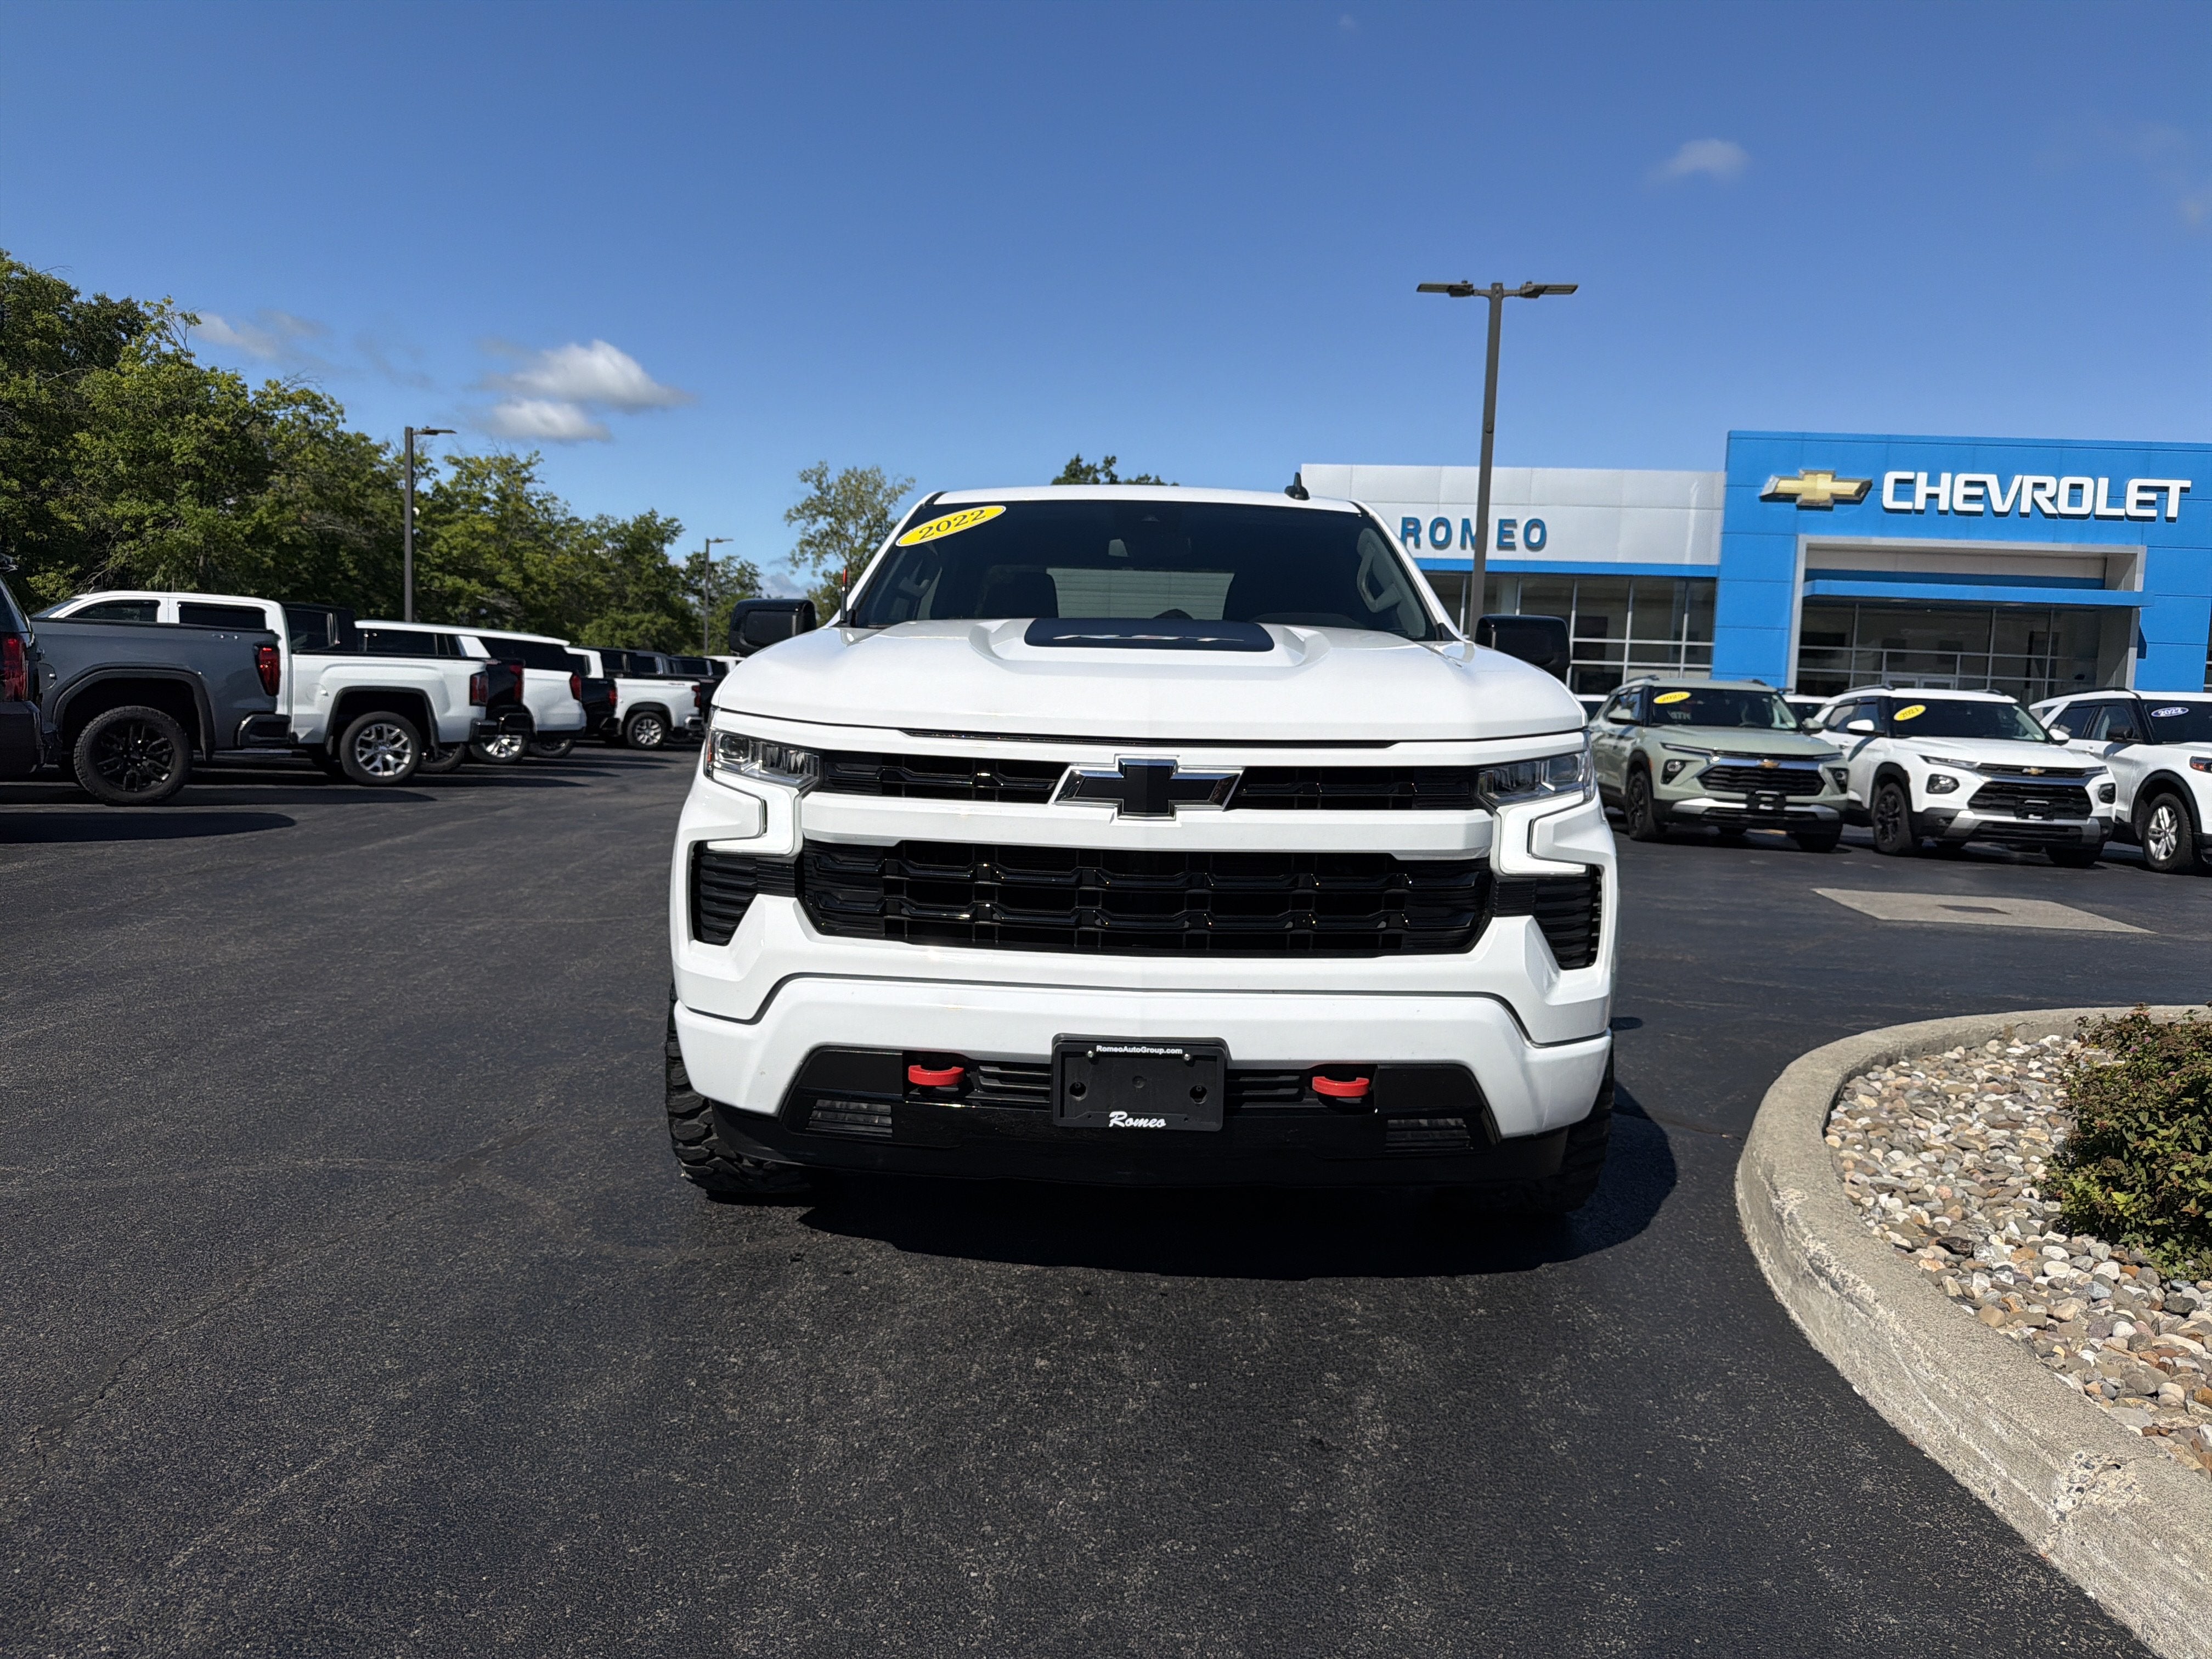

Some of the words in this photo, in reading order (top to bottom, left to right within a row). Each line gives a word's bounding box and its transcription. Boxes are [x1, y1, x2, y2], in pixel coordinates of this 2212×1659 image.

[1882, 471, 2192, 518] CHEVROLET
[918, 510, 986, 540] 2022
[2158, 708, 2183, 716] 2022
[1096, 1045, 1183, 1055] RomeoAutoGroup.com
[1109, 1111, 1167, 1128] Romeo
